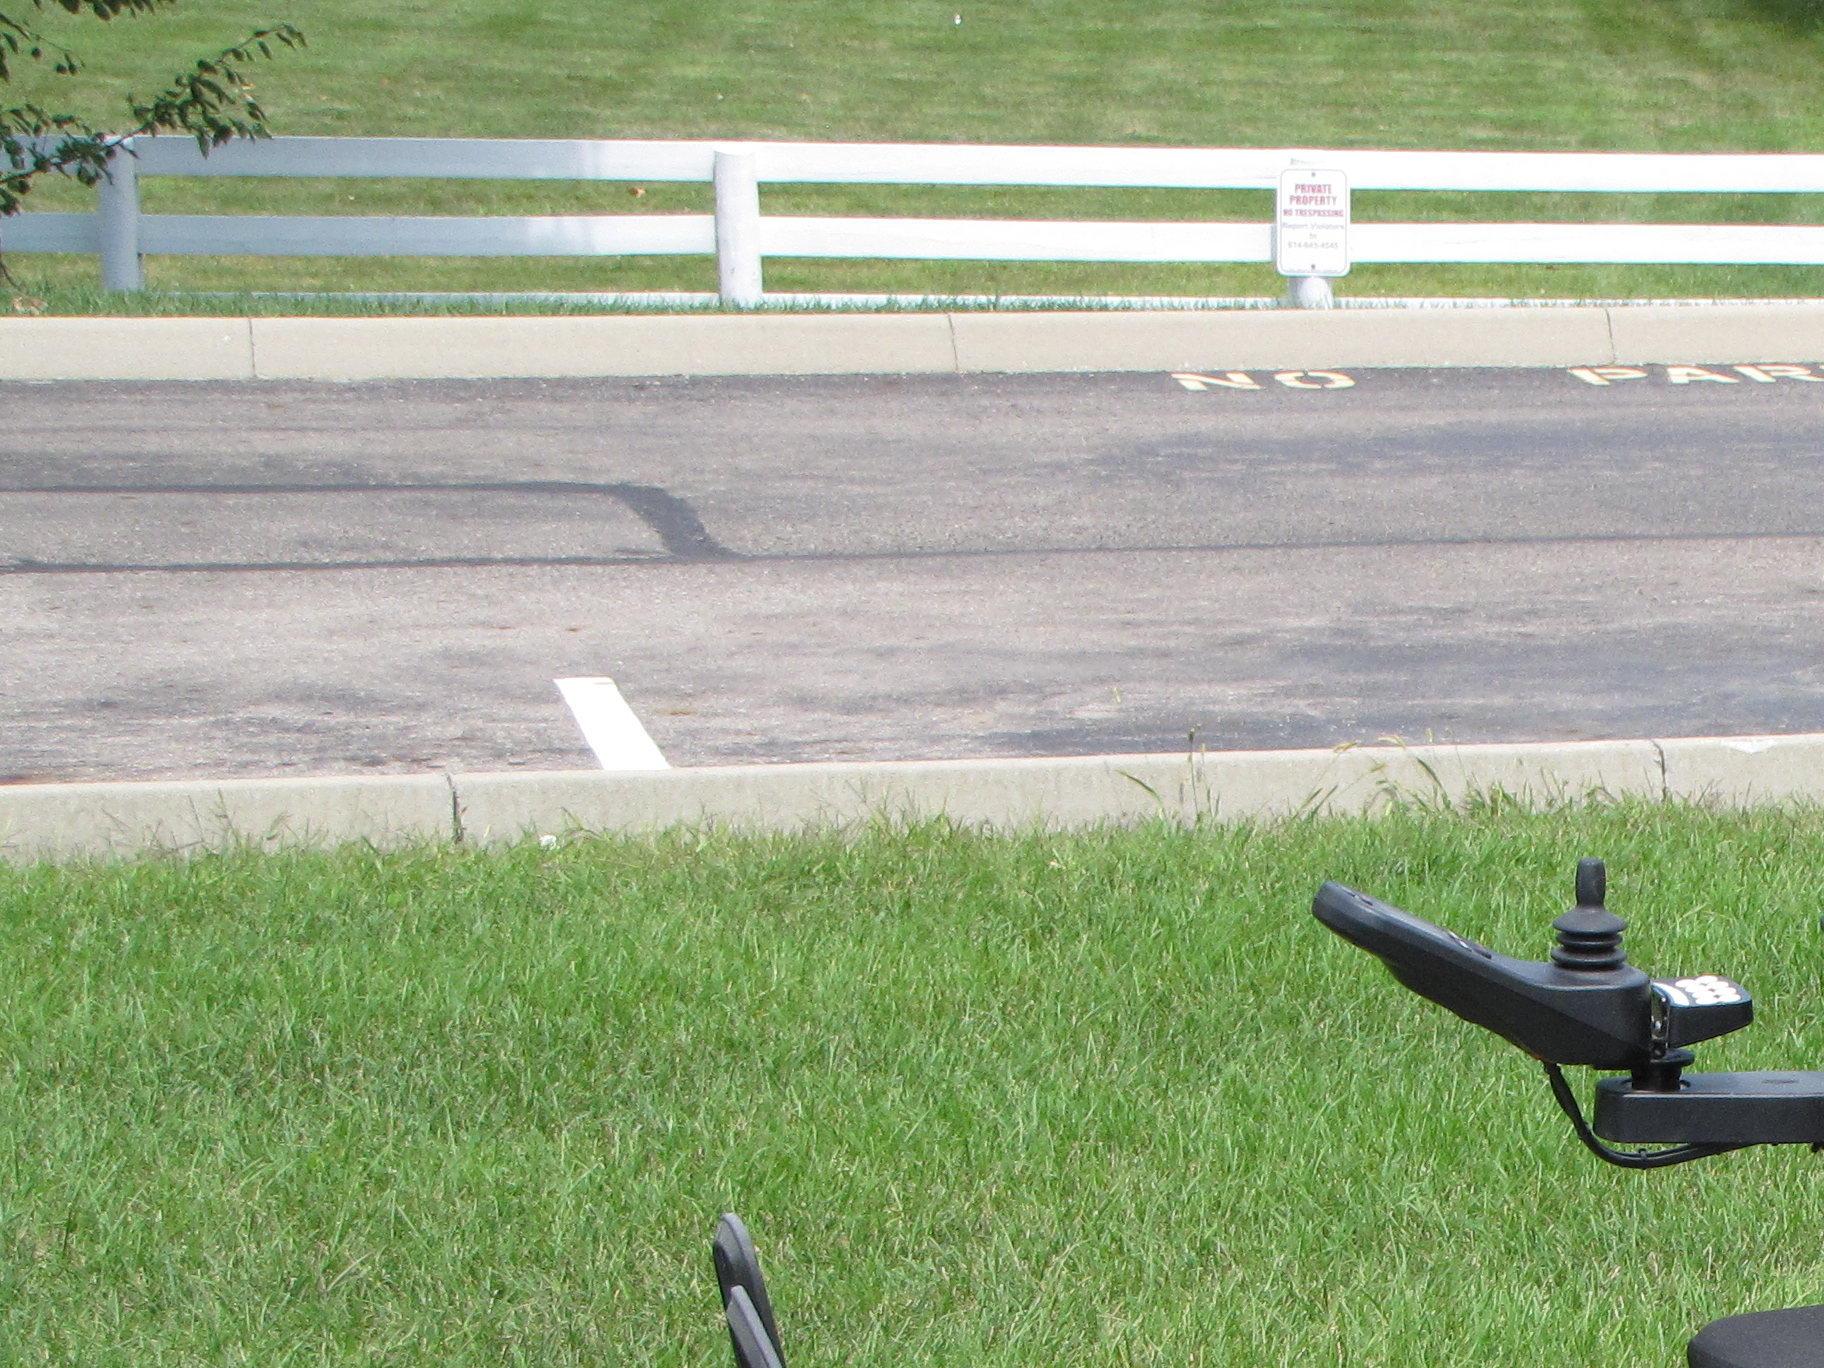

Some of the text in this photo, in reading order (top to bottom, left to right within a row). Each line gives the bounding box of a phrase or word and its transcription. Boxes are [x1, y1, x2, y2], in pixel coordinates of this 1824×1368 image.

[1294, 184, 1332, 195] PRIVATE
[1289, 195, 1338, 206] PROPERTY
[1283, 208, 1345, 218] NO TRESPASSING
[1282, 222, 1309, 230] Report
[1171, 369, 1355, 391] NO
